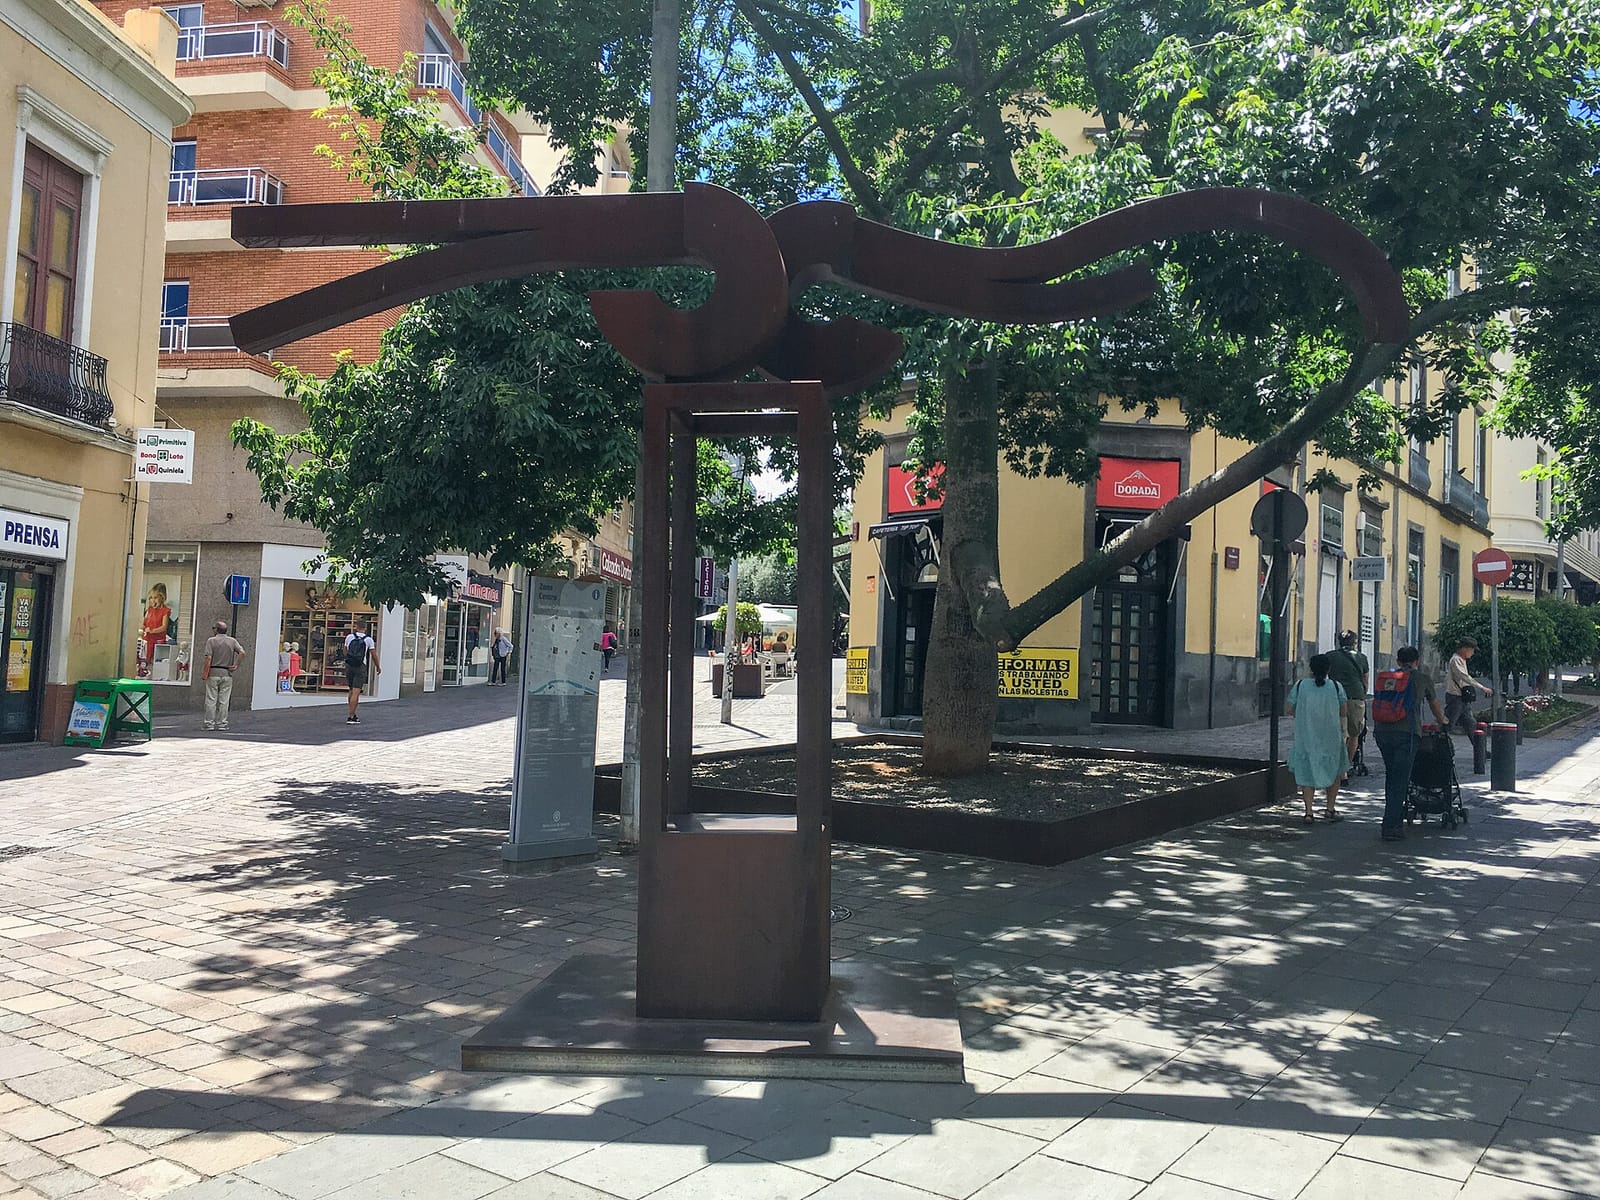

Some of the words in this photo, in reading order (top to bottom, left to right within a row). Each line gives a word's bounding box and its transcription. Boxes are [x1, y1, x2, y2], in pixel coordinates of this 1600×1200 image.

[1117, 485, 1158, 496] DORADA
[4, 520, 60, 549] PRENSA
[998, 659, 1069, 671] EFORMAS
[1007, 671, 1069, 680] TRABAJANDO
[1012, 679, 1062, 689] USTED
[1005, 688, 1021, 696] LAS
[1022, 688, 1069, 697] MOLESTIAS
